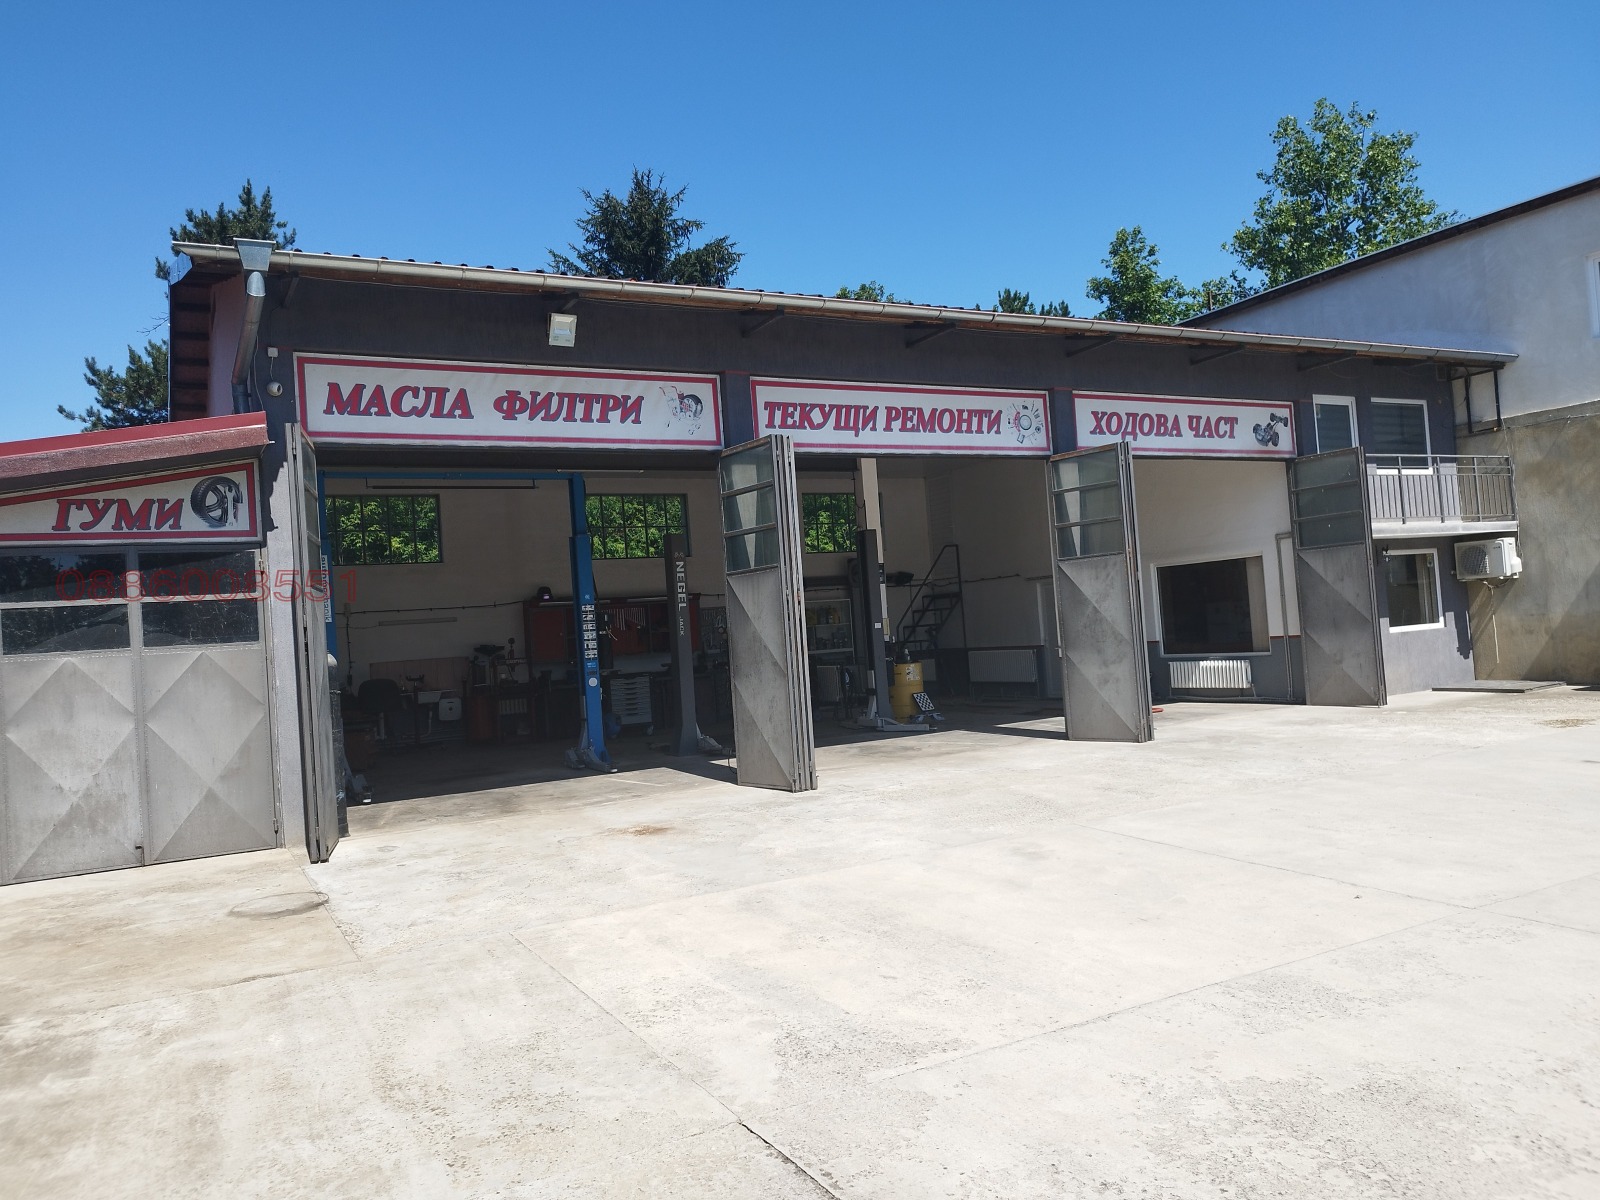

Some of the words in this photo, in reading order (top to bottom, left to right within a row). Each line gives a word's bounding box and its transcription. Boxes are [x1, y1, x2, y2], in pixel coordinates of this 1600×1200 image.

[323, 382, 474, 419] МАСЛА
[493, 389, 644, 425] ФИЛТРИ
[764, 401, 879, 437] ТЕКУЩИ
[883, 406, 1003, 434] РЕМОНТИ
[1089, 410, 1183, 441] ХОДОВА
[1187, 414, 1238, 439] ЧАСТ
[51, 498, 184, 531] ГУМИ
[675, 561, 687, 612] NEGEL
